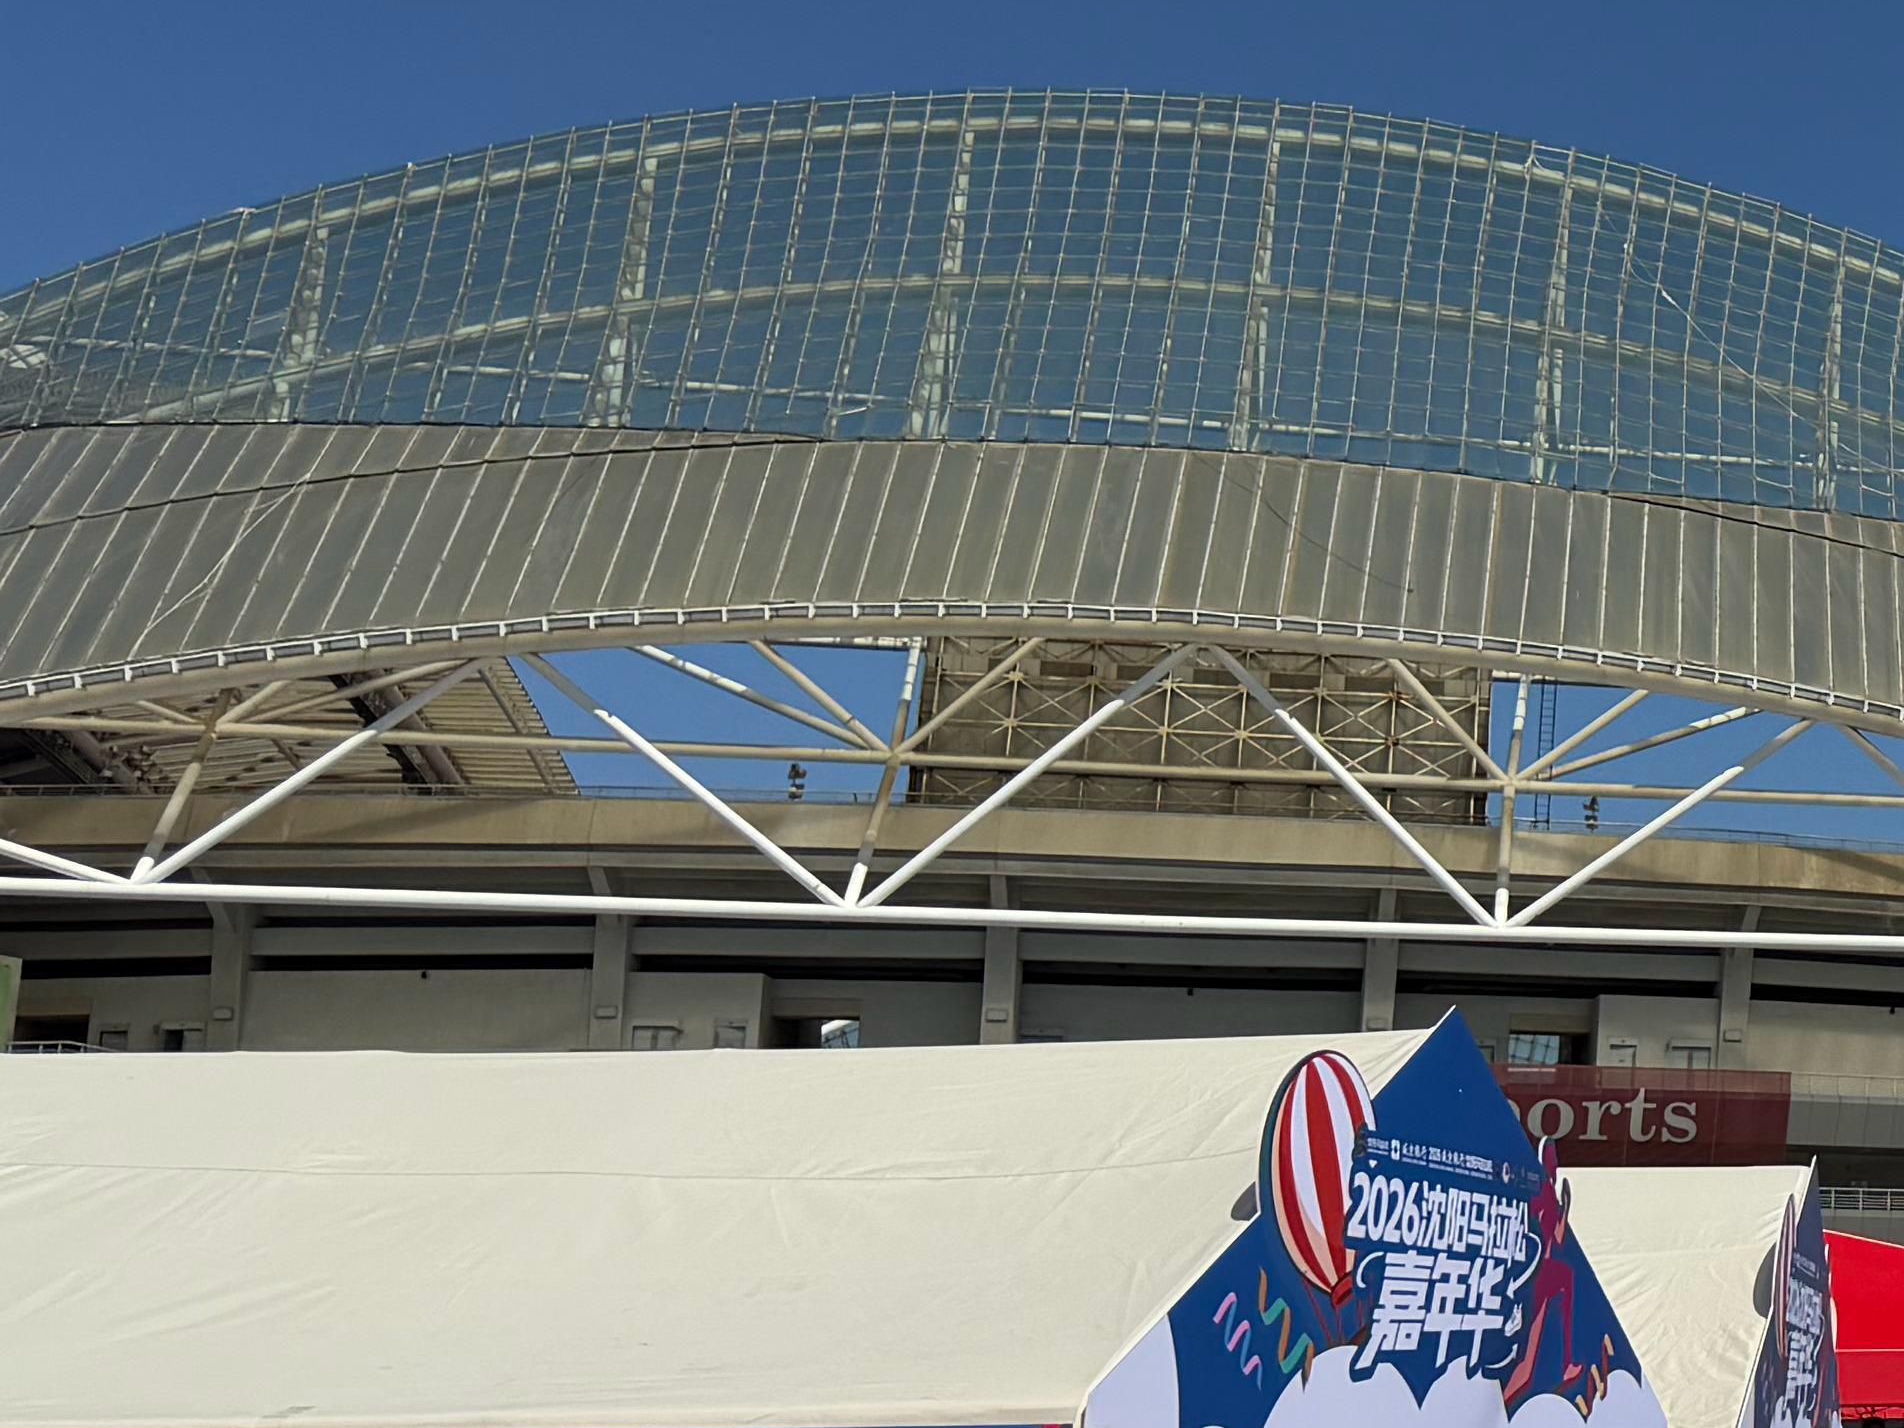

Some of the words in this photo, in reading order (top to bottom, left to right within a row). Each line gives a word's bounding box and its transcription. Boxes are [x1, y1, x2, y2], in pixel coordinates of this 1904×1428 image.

[1508, 1087, 1697, 1144] orts
[1347, 1176, 1529, 1263] 2026沈阳马拉松
[1355, 1250, 1508, 1370] 嘉年华
